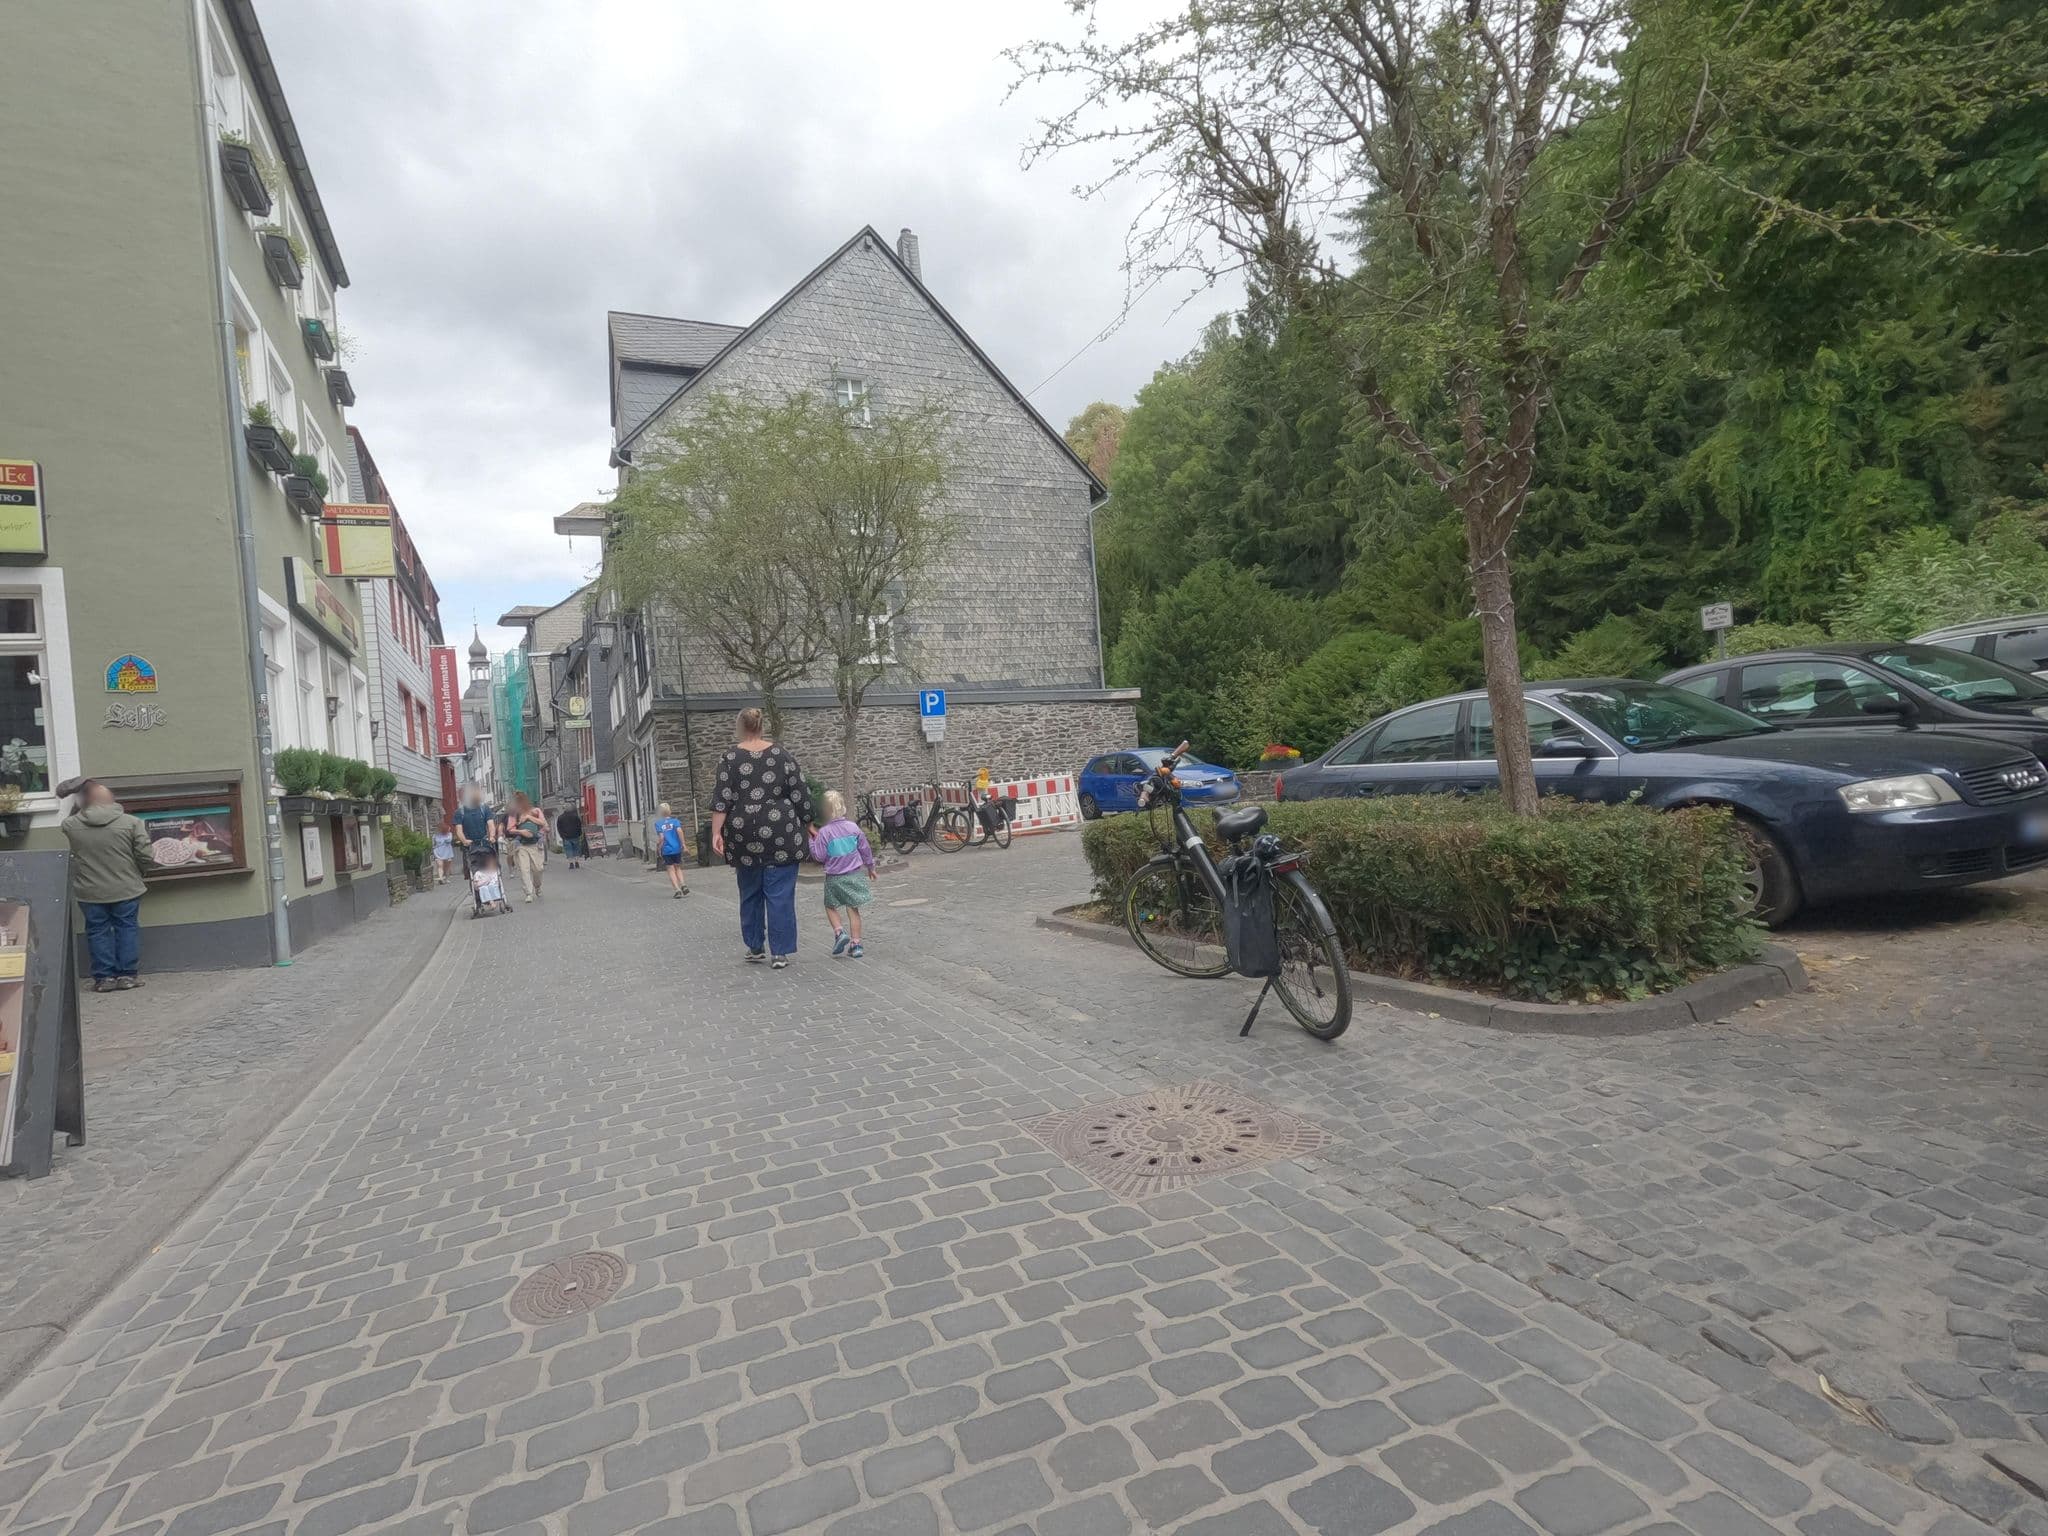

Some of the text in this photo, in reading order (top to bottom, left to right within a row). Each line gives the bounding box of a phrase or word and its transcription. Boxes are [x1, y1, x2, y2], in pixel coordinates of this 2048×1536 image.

[439, 654, 454, 727] Tourist Information
[926, 693, 940, 714] P
